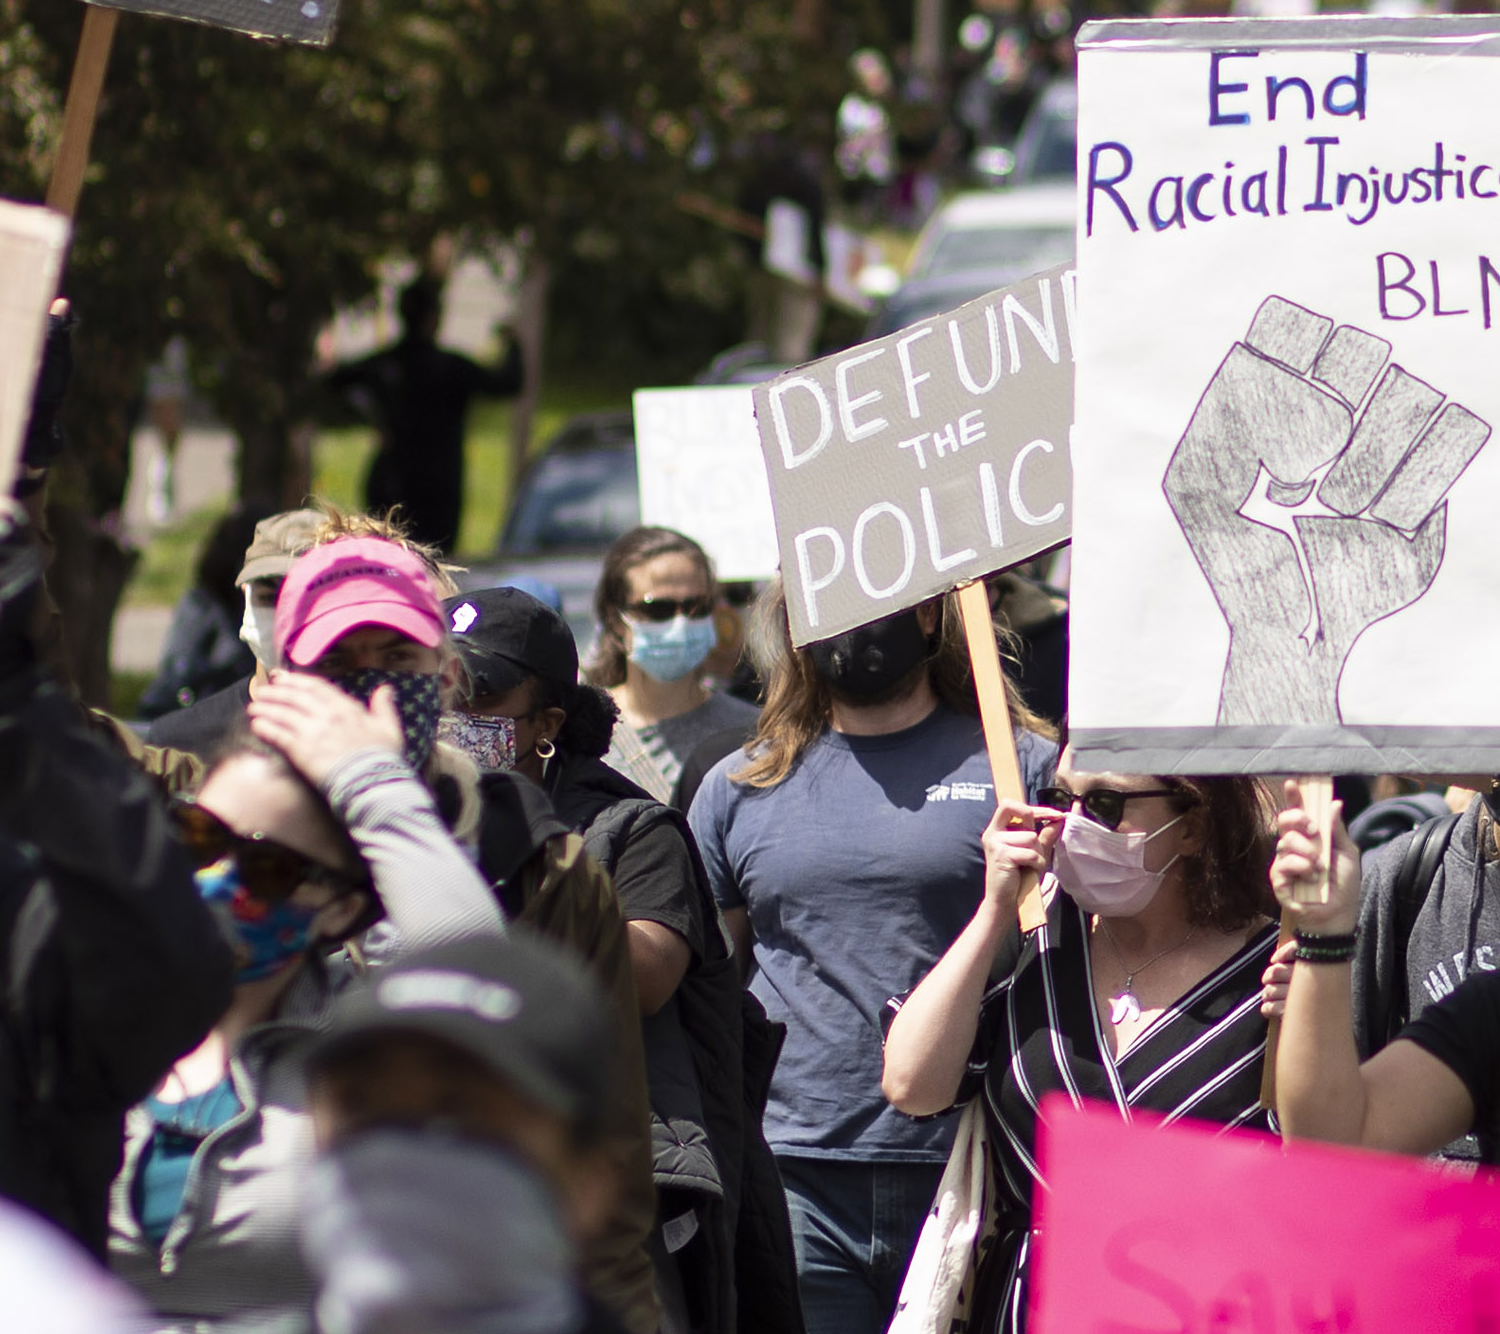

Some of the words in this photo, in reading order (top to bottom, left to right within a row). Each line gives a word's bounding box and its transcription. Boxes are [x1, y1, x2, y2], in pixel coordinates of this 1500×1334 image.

[1208, 51, 1368, 127] End
[1087, 142, 1288, 238] Racial
[899, 409, 987, 469] THE
[793, 424, 1076, 627] POLIC
